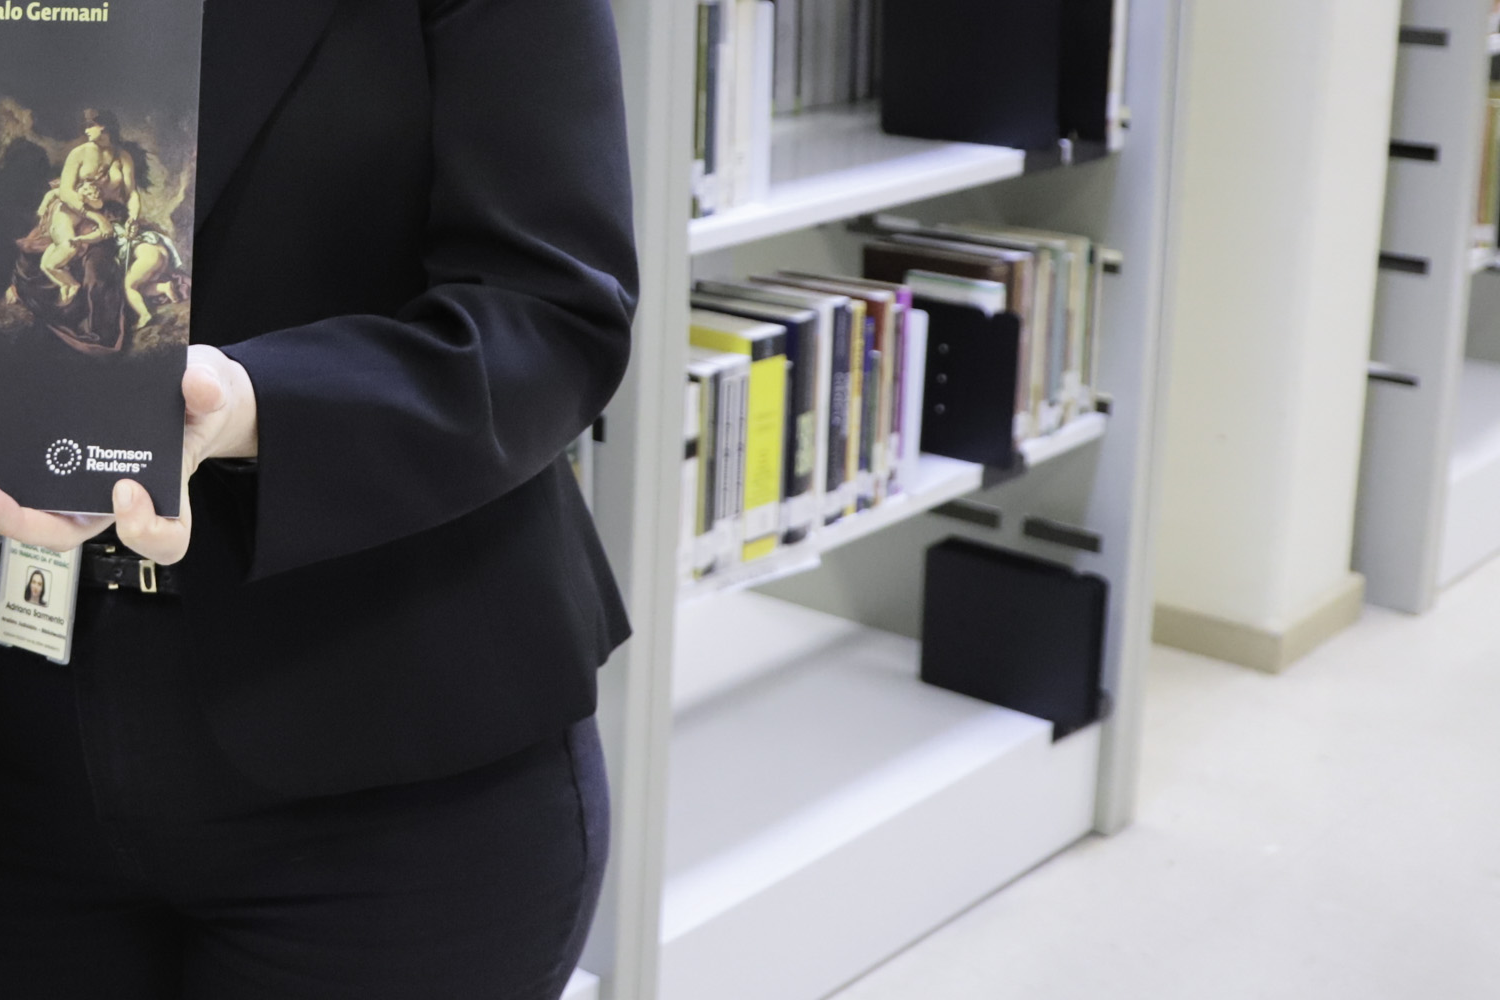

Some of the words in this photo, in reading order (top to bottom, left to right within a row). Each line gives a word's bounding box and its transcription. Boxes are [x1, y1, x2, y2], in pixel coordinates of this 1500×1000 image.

[26, 0, 109, 23] Germani
[86, 446, 152, 462] Thomson
[6, 601, 32, 616] Adriana
[33, 608, 65, 626] Sarmento
